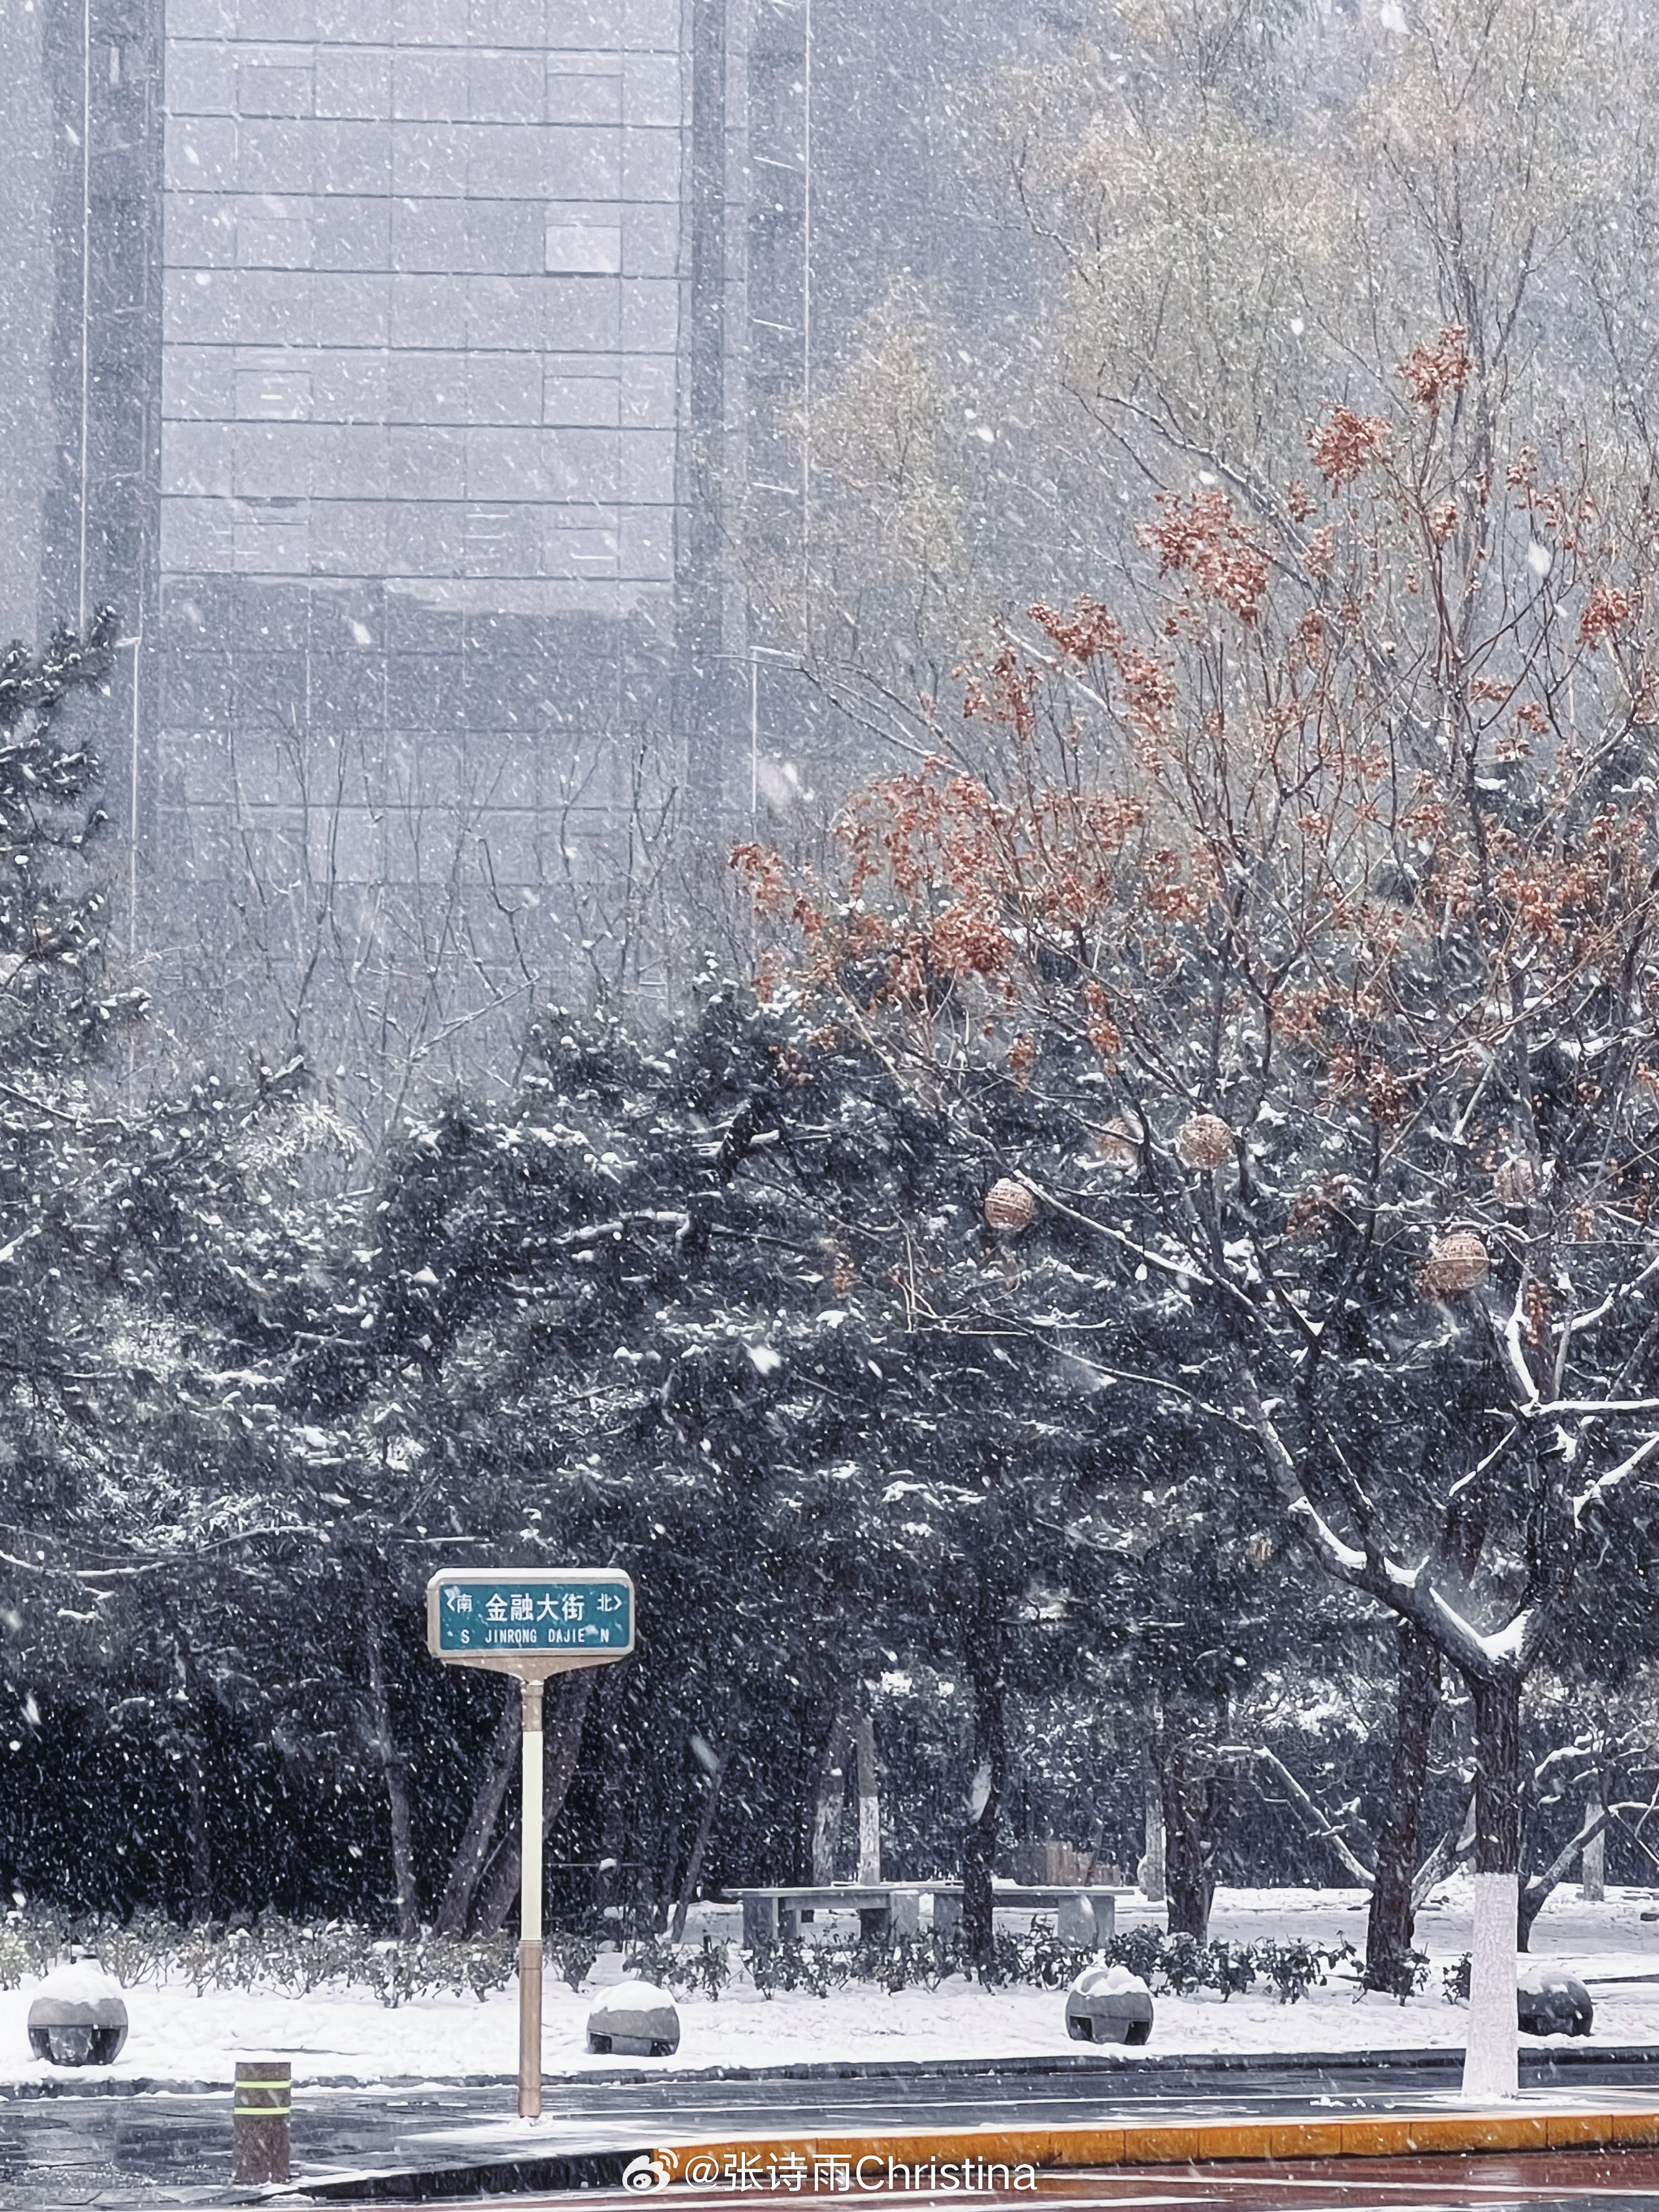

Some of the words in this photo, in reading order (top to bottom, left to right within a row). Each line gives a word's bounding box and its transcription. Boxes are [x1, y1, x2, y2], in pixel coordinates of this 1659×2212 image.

[457, 1594, 472, 1613] 南
[486, 1593, 584, 1621] 金融大街
[597, 1593, 612, 1612] 北
[461, 1629, 470, 1644] S
[485, 1629, 537, 1643] JINRONG
[549, 1628, 584, 1643] DAJIE
[600, 1628, 610, 1643] N
